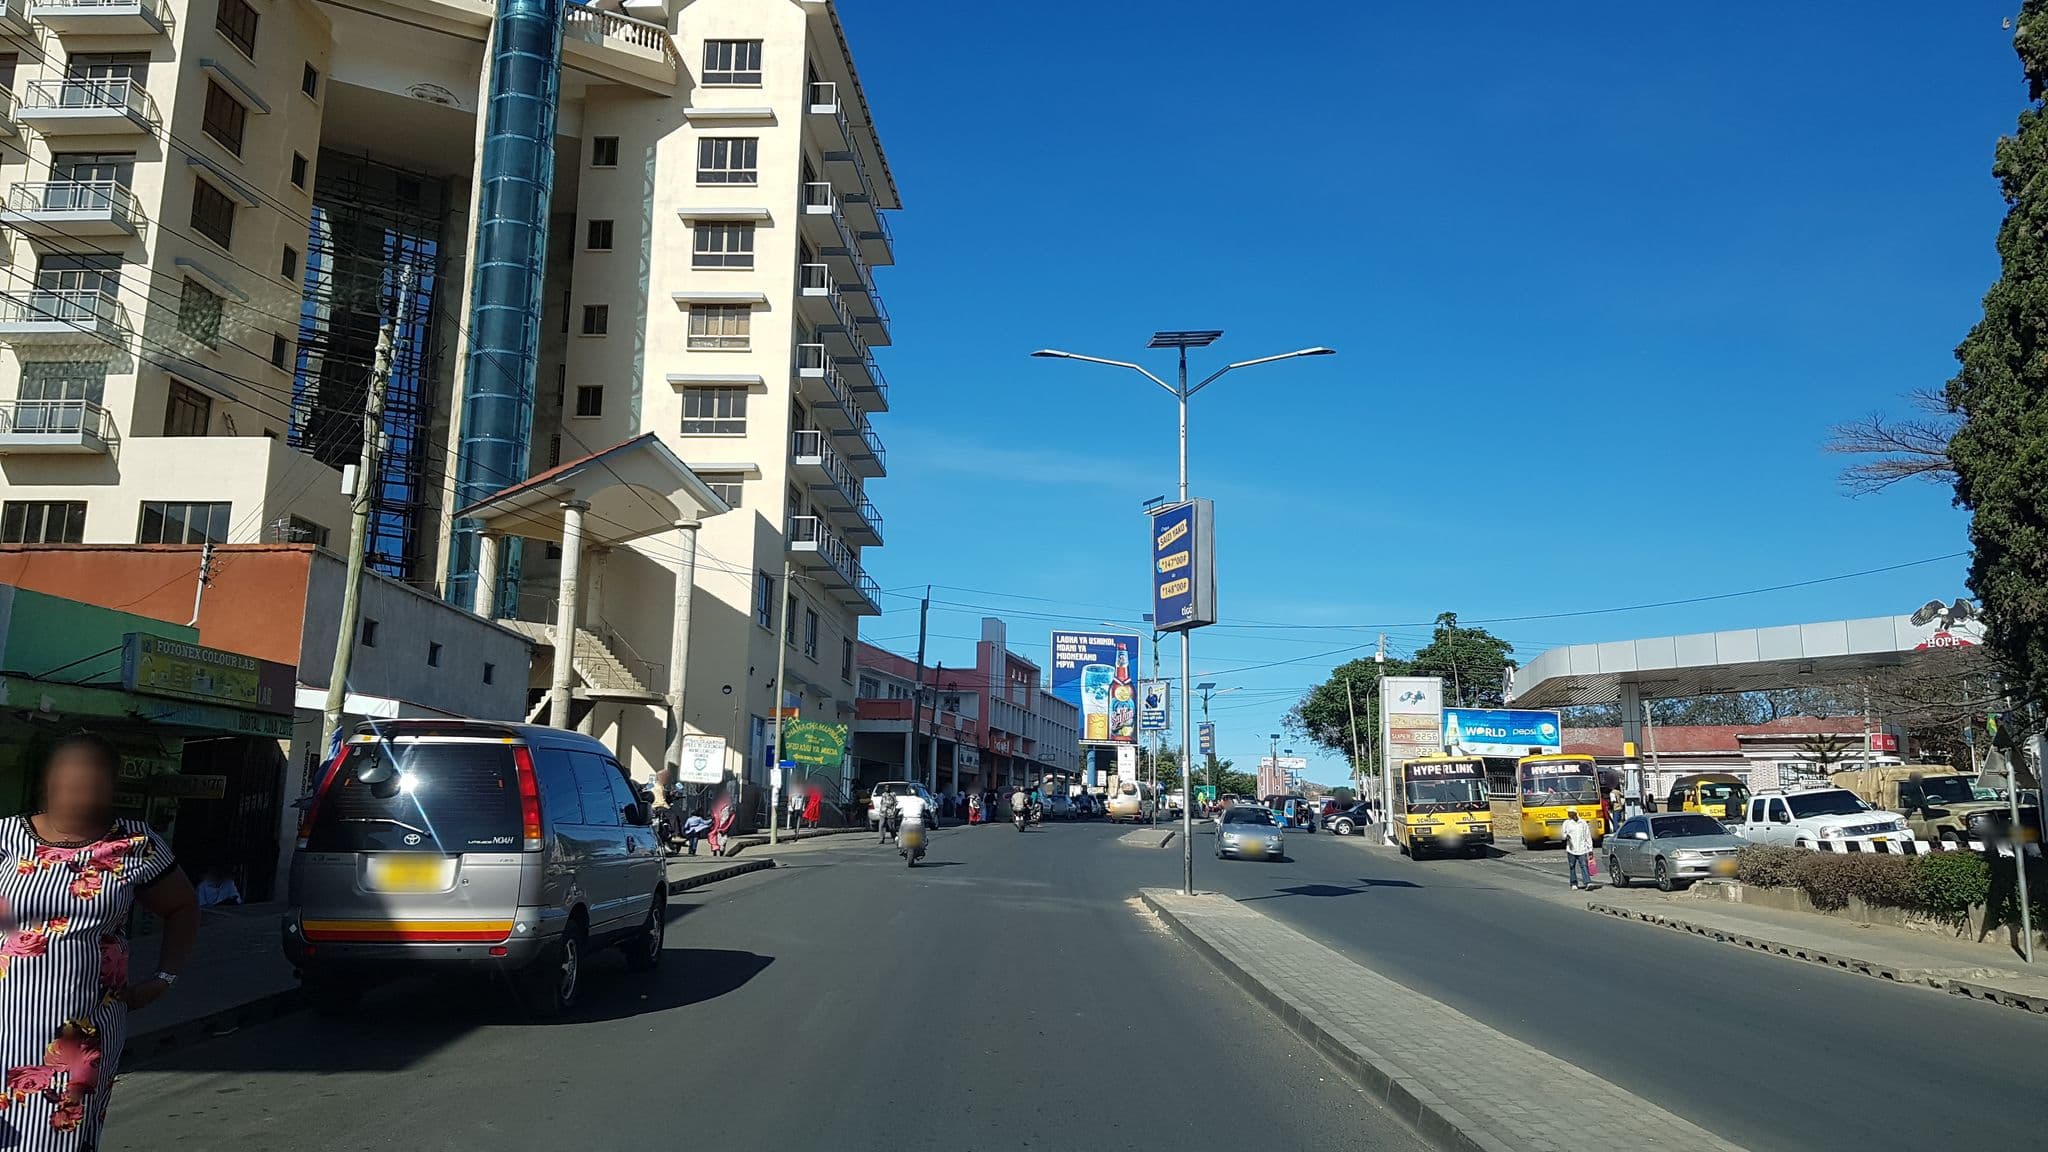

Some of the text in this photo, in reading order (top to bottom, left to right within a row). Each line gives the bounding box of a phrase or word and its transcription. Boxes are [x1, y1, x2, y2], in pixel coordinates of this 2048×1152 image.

[1181, 603, 1193, 617] tigo
[1079, 636, 1088, 645] YA
[1927, 637, 1960, 648] HOPE
[157, 640, 201, 660] FOTONEX
[202, 649, 238, 666] COLOUR
[1078, 644, 1087, 652] YA
[1415, 732, 1438, 741] 2256
[1465, 727, 1506, 738] WORLD
[1512, 728, 1537, 737] pepsi
[1413, 763, 1474, 776] HYPERLINK
[492, 836, 515, 845] NOAH
